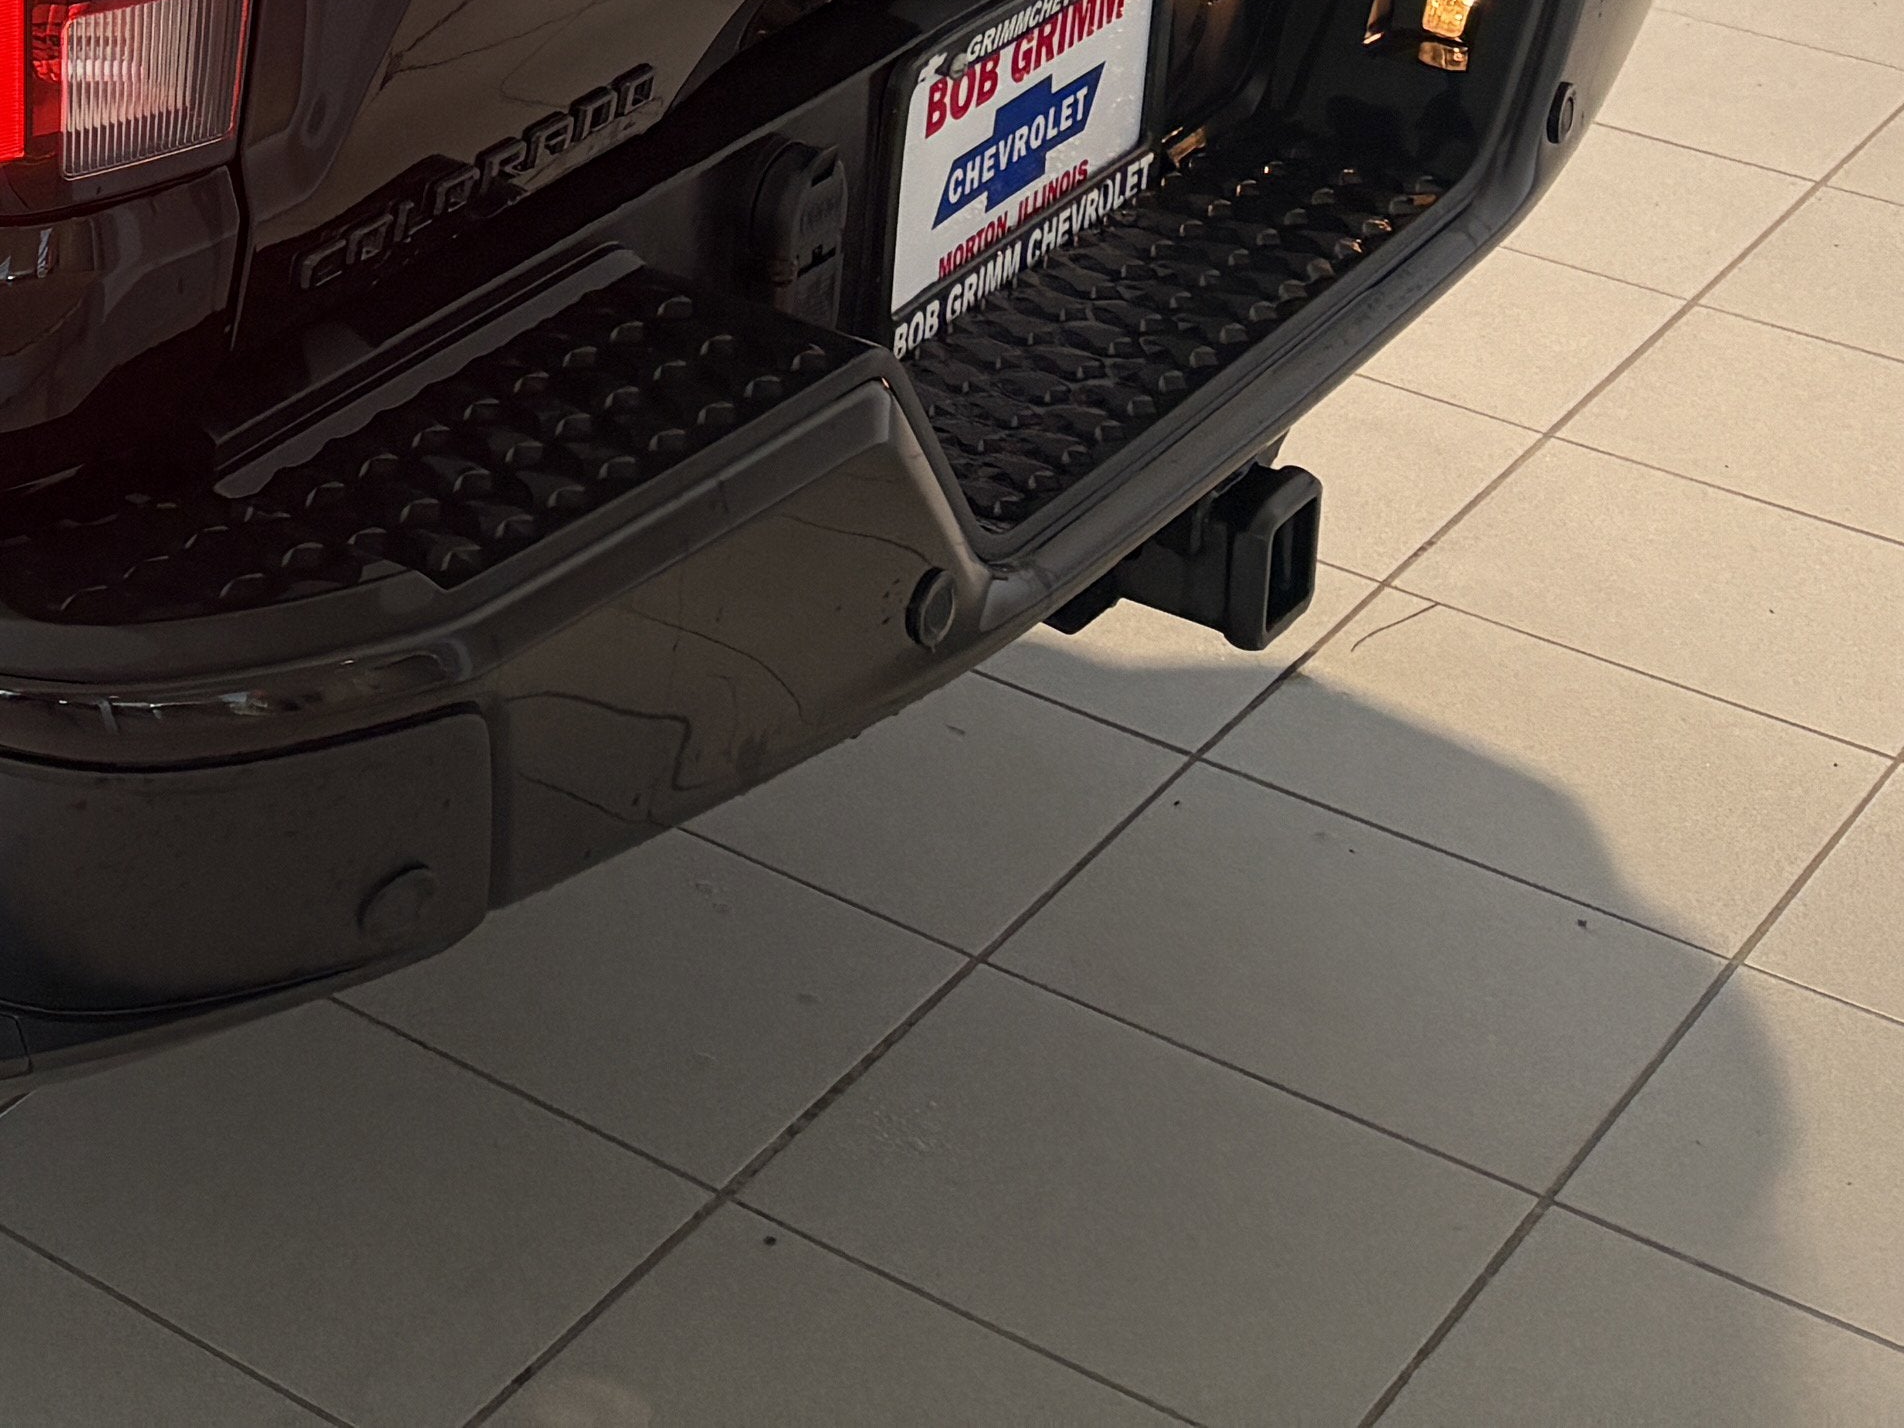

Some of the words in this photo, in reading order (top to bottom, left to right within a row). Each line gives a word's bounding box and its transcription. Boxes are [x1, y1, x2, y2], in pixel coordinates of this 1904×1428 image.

[925, 52, 1000, 139] BOB
[948, 86, 1090, 204] CHEVROLET
[1019, 159, 1089, 226] ILLINOIS
[893, 300, 940, 361] BOB
[946, 241, 1021, 324] GRIMM
[1026, 151, 1155, 264] CHEVROLET
